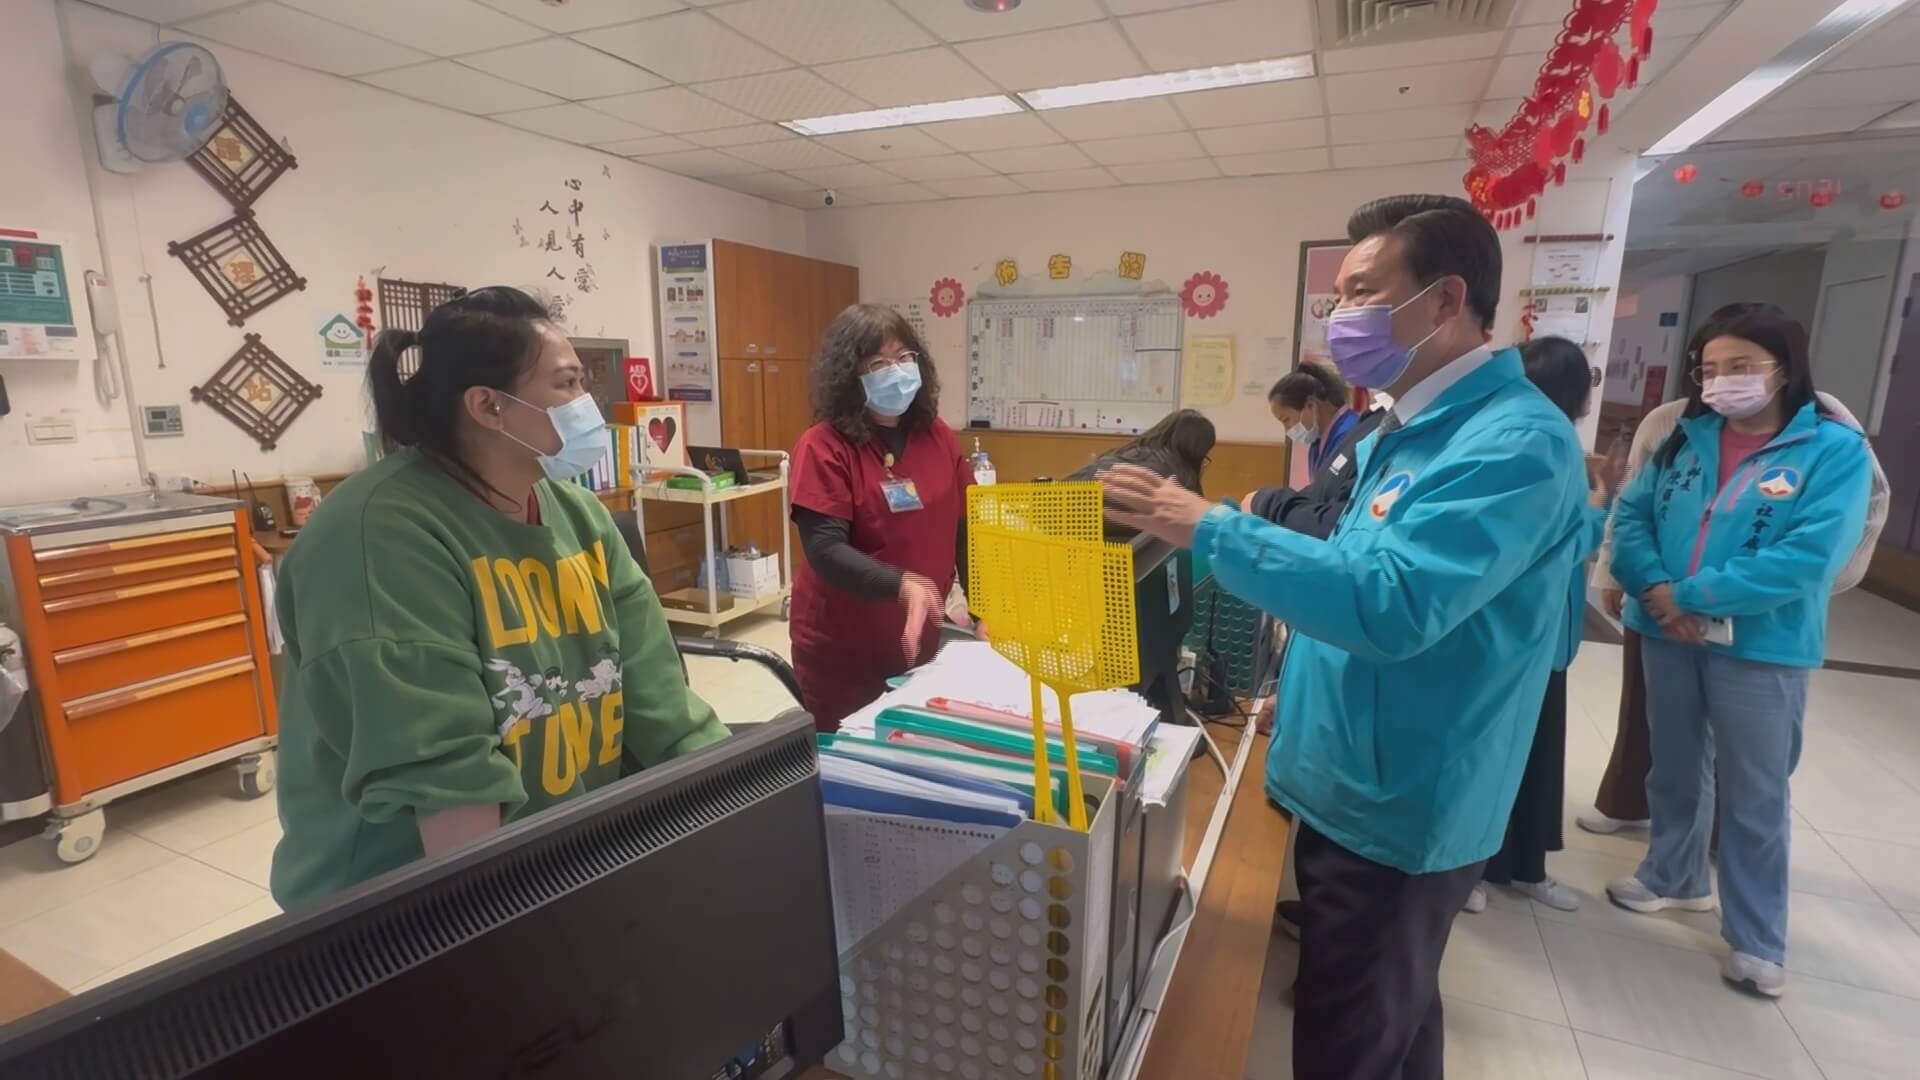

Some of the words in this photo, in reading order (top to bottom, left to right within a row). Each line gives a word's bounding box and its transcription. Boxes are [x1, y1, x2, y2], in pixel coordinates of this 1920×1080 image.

[563, 178, 591, 294] 心中有愛
[628, 364, 647, 374] AED
